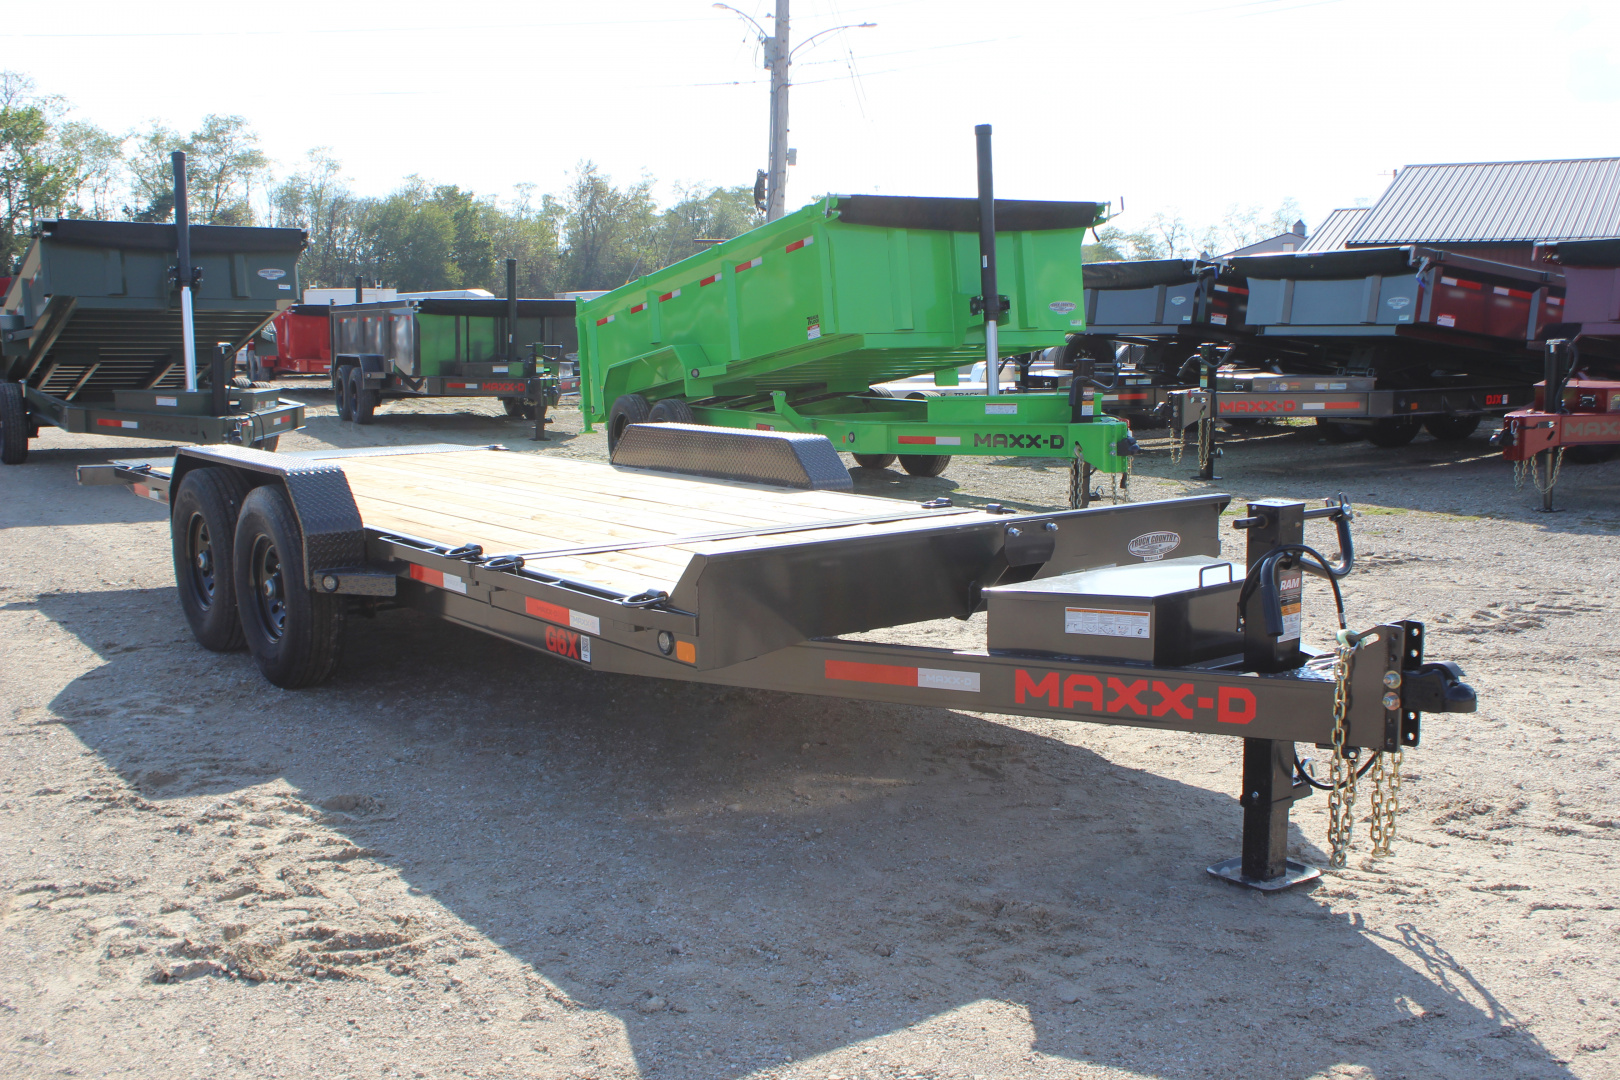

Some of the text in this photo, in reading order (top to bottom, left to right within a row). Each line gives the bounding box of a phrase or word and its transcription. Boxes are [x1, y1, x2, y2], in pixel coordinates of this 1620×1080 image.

[482, 381, 525, 392] MAXX-D
[1220, 400, 1296, 413] MAXX-D
[1486, 394, 1502, 405] DJX
[1564, 421, 1620, 437] MAX
[974, 433, 1064, 449] MAXX-D
[1130, 534, 1178, 549] TRUCK COUNTRY
[1280, 577, 1300, 591] RAM
[545, 625, 579, 660] G6X
[925, 674, 971, 686] MAXX-D
[1015, 669, 1256, 724] MAXX-D
